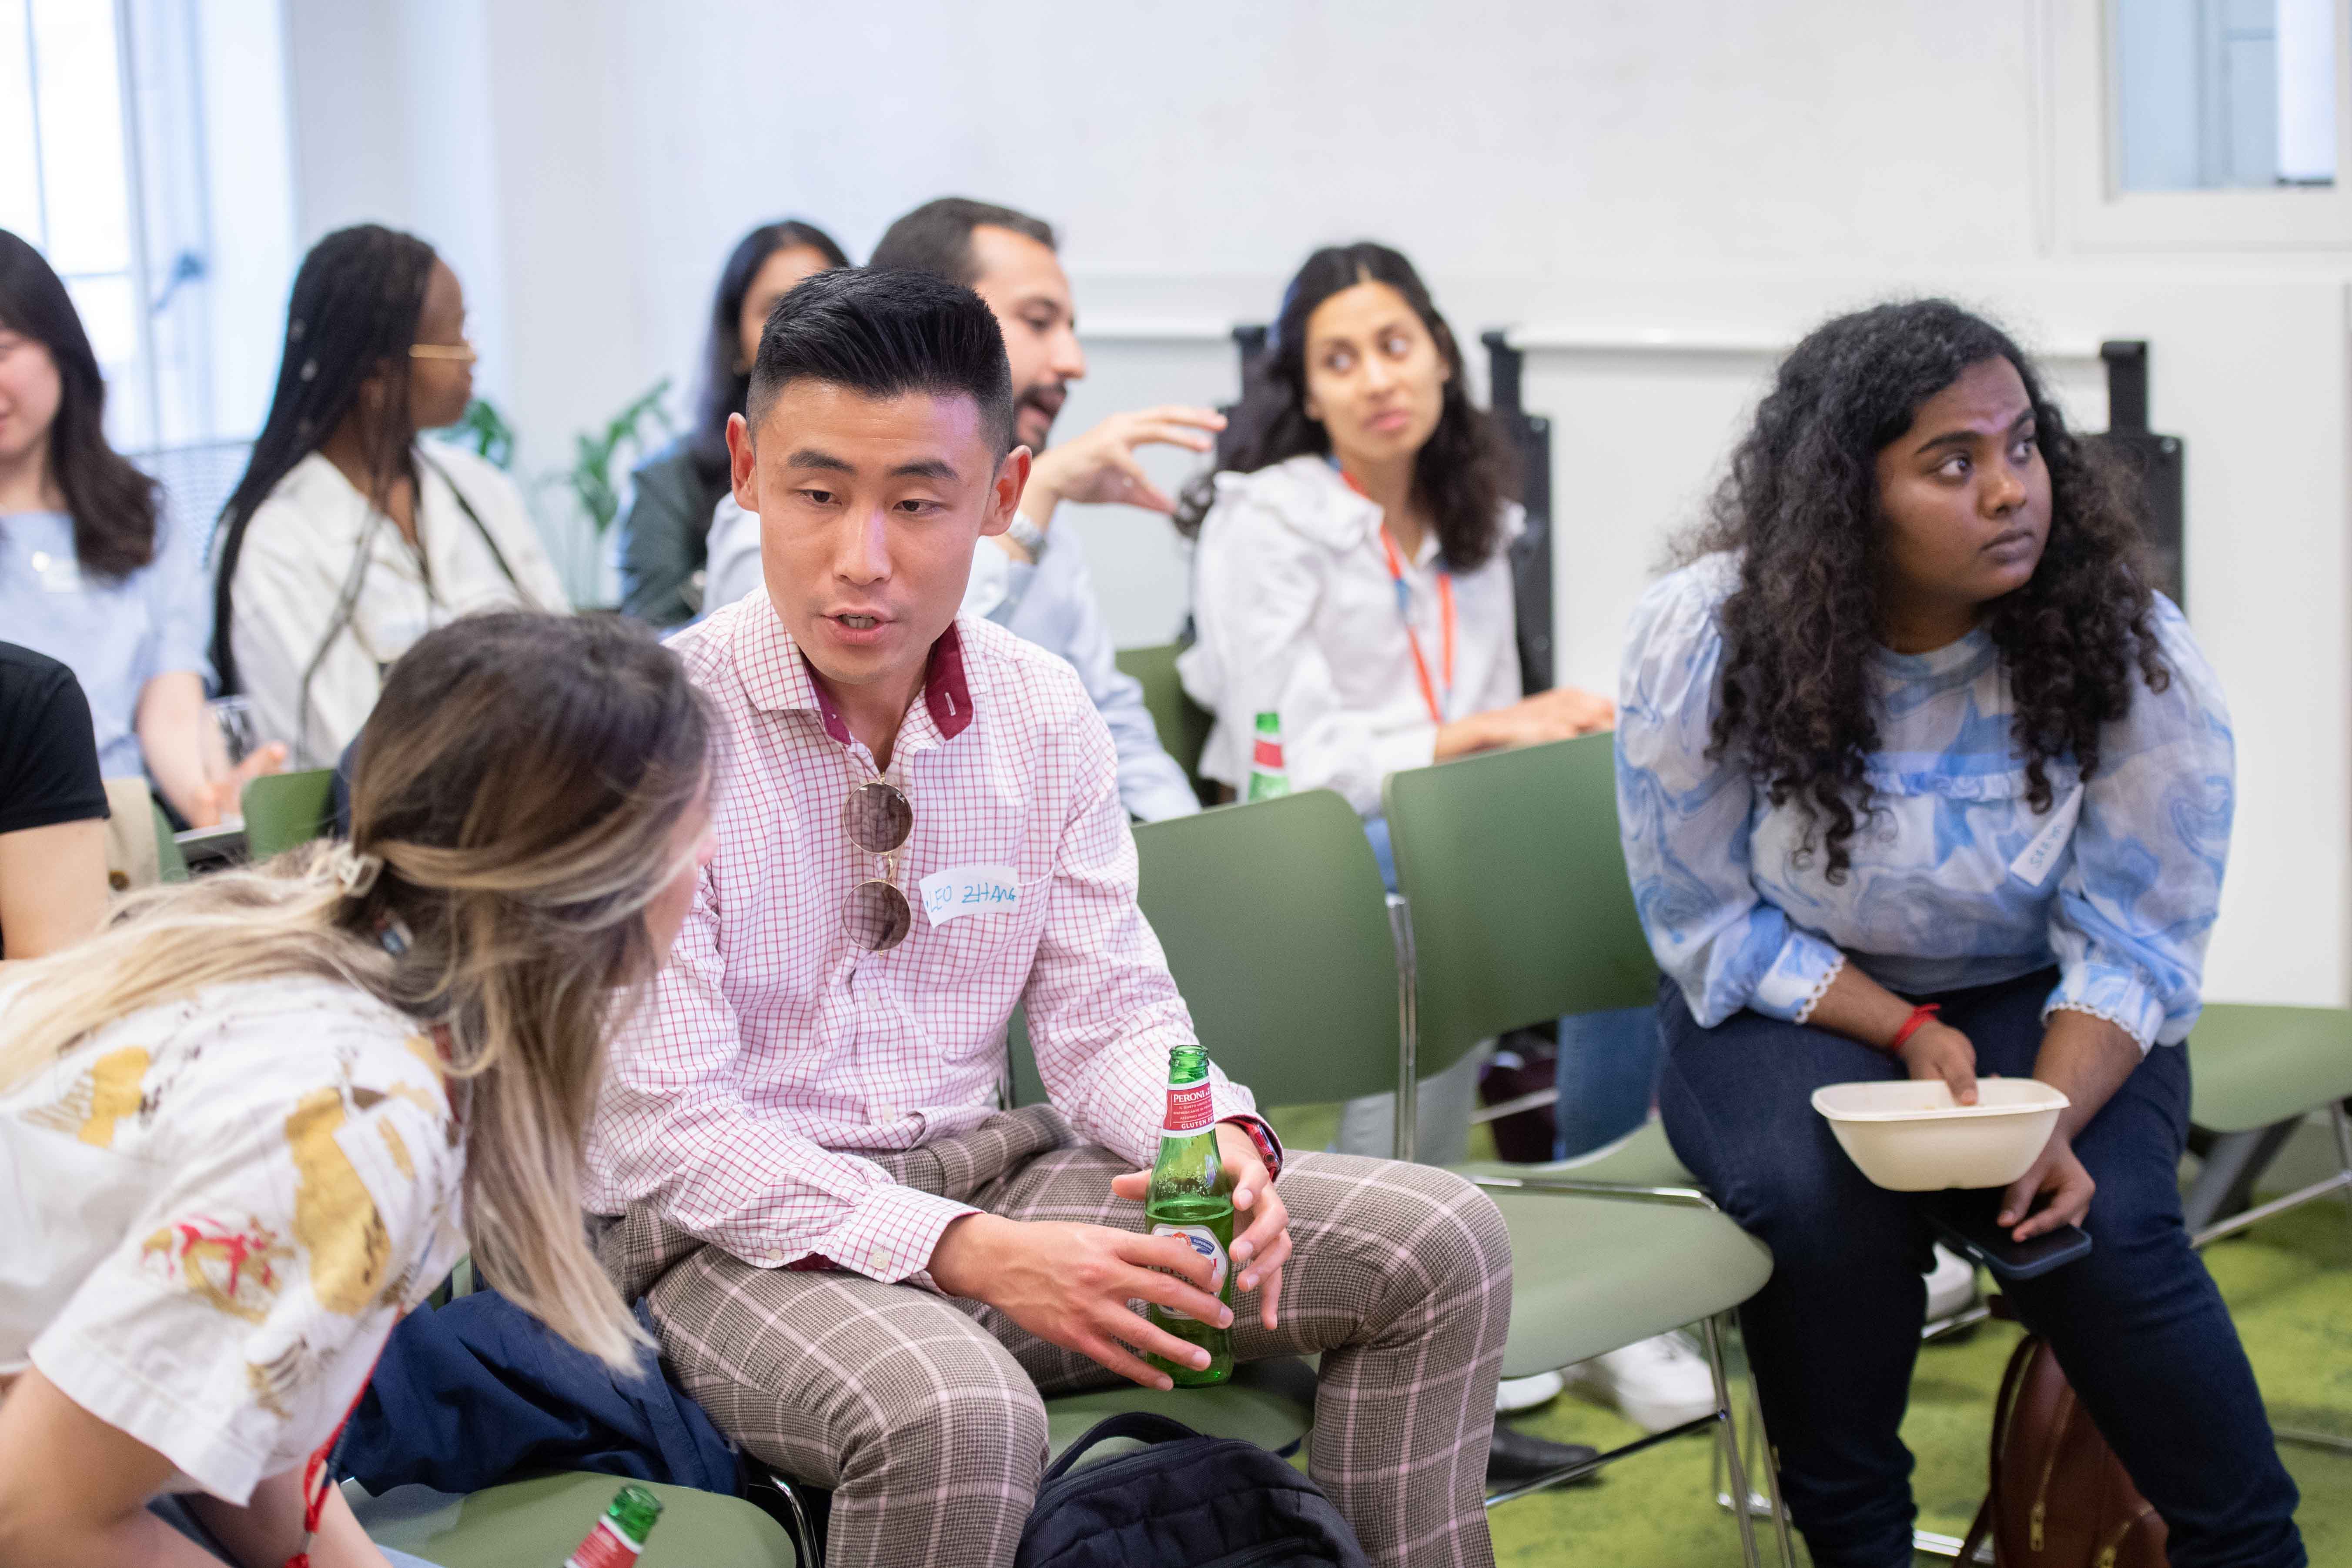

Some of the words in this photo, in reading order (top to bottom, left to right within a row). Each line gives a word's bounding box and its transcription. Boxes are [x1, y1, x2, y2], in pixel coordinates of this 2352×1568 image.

[929, 886, 952, 913] LEO
[961, 882, 1017, 903] ZHANG
[1174, 1090, 1205, 1103] PERONI
[1181, 1119, 1207, 1129] GLUTEN
[1193, 1239, 1214, 1250] SUPERIORE
